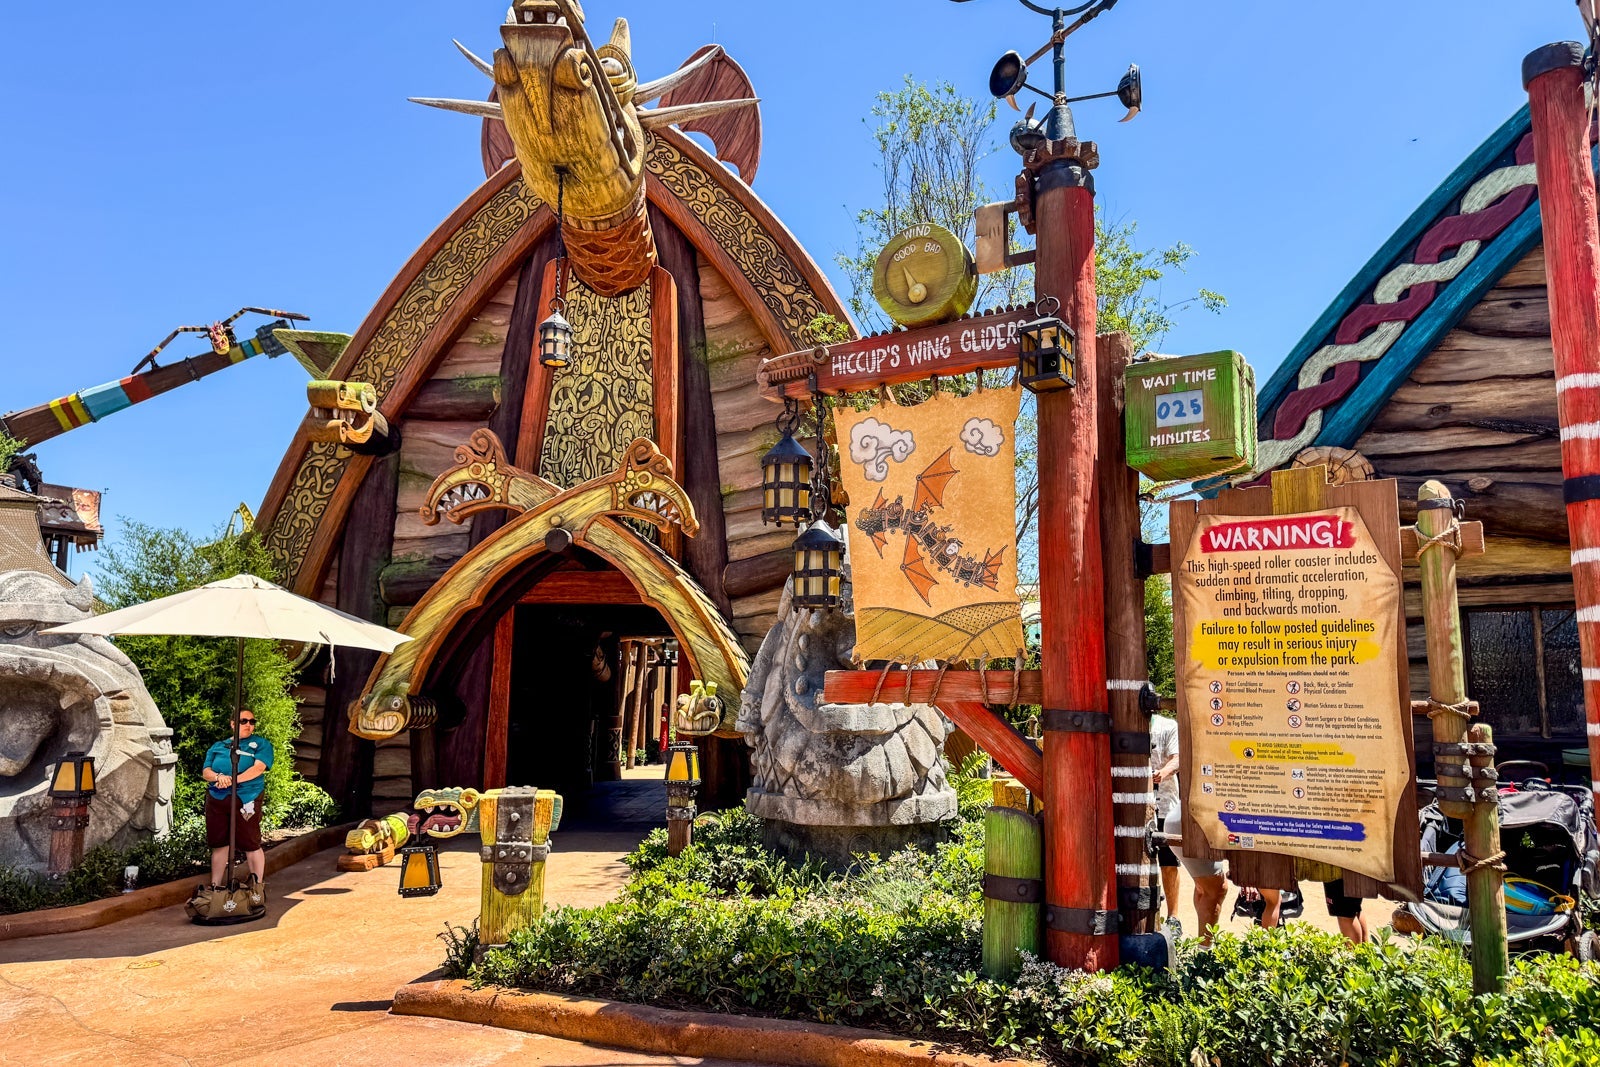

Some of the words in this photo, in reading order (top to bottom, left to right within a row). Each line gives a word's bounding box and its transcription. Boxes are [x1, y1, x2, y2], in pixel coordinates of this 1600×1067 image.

[902, 225, 931, 240] WIND
[894, 243, 917, 262] GOOD
[924, 242, 941, 254] BAD
[832, 345, 900, 376] HICCUP'S
[907, 336, 951, 366] WING
[1142, 373, 1177, 390] WAIT
[1183, 368, 1216, 384] TIME
[1158, 399, 1201, 420] 025
[1150, 429, 1210, 447] MINUTES
[1209, 521, 1342, 550] WARNING!
[1187, 560, 1205, 572] This
[1209, 558, 1260, 574] high-speed
[1265, 555, 1291, 568] roller
[1295, 554, 1330, 567] coaster
[1335, 551, 1377, 565] includes
[1196, 574, 1229, 587] sudden
[1234, 573, 1250, 586] and
[1255, 572, 1298, 584] dramatic
[1303, 569, 1368, 583] acceleration,
[1216, 589, 1259, 603] climbing,
[1263, 588, 1294, 602] tilting,
[1298, 586, 1348, 600] dropping,
[1224, 604, 1241, 616] and
[1245, 602, 1297, 616] backwards
[1302, 602, 1340, 614] motion.
[1201, 622, 1234, 635] Failure
[1237, 622, 1247, 634] to
[1251, 620, 1280, 634] follow
[1284, 619, 1317, 636] posted
[1321, 618, 1374, 635] guidelines
[1218, 638, 1239, 652] may
[1243, 637, 1270, 649] result
[1274, 637, 1283, 649] in
[1287, 636, 1322, 649] serious
[1326, 637, 1356, 652] injury
[1218, 656, 1227, 665] or
[1232, 652, 1279, 668] expulsion
[1282, 652, 1306, 665] from
[1310, 652, 1327, 664] the
[1331, 652, 1359, 667] park.
